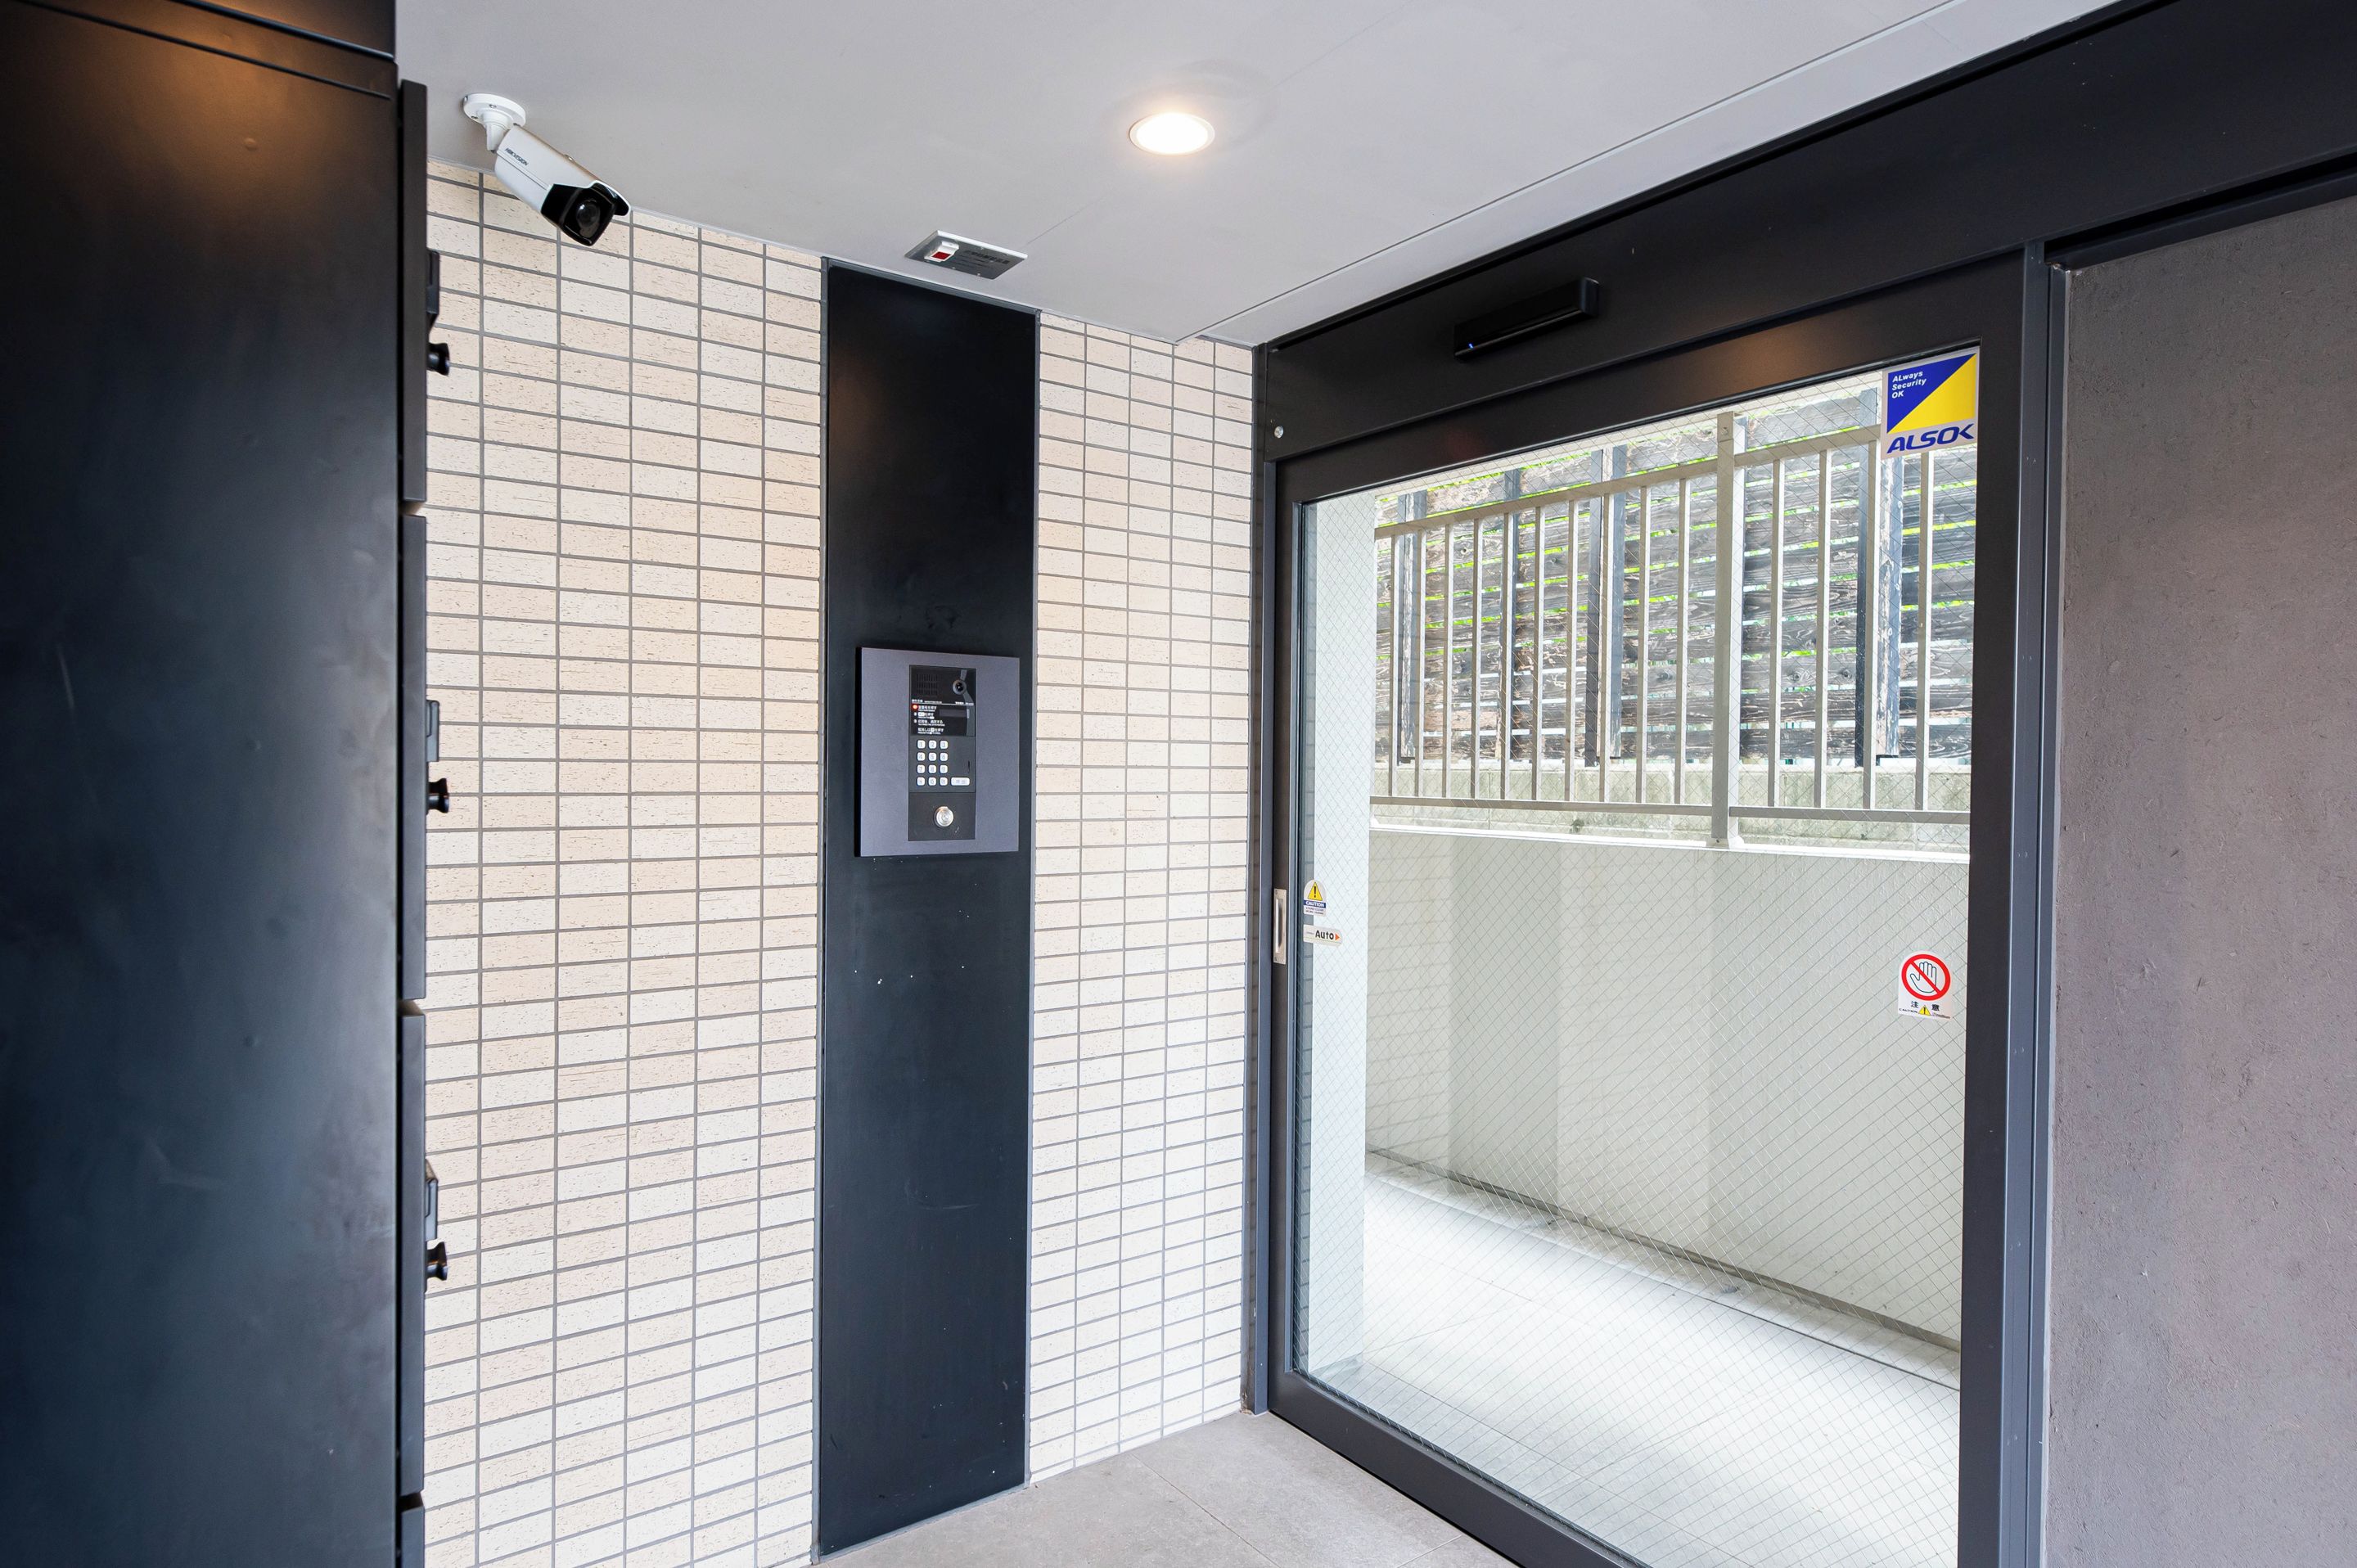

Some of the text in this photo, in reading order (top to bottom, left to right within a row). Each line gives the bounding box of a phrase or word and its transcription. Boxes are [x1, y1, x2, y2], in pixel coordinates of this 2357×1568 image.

[504, 147, 529, 165] HIKVISION
[1892, 371, 1923, 383] ALways
[1891, 378, 1927, 390] Security
[1891, 390, 1904, 399] OK
[1886, 423, 1975, 454] ALSOK
[1315, 930, 1334, 939] Auto
[1911, 1000, 1918, 1008] 注
